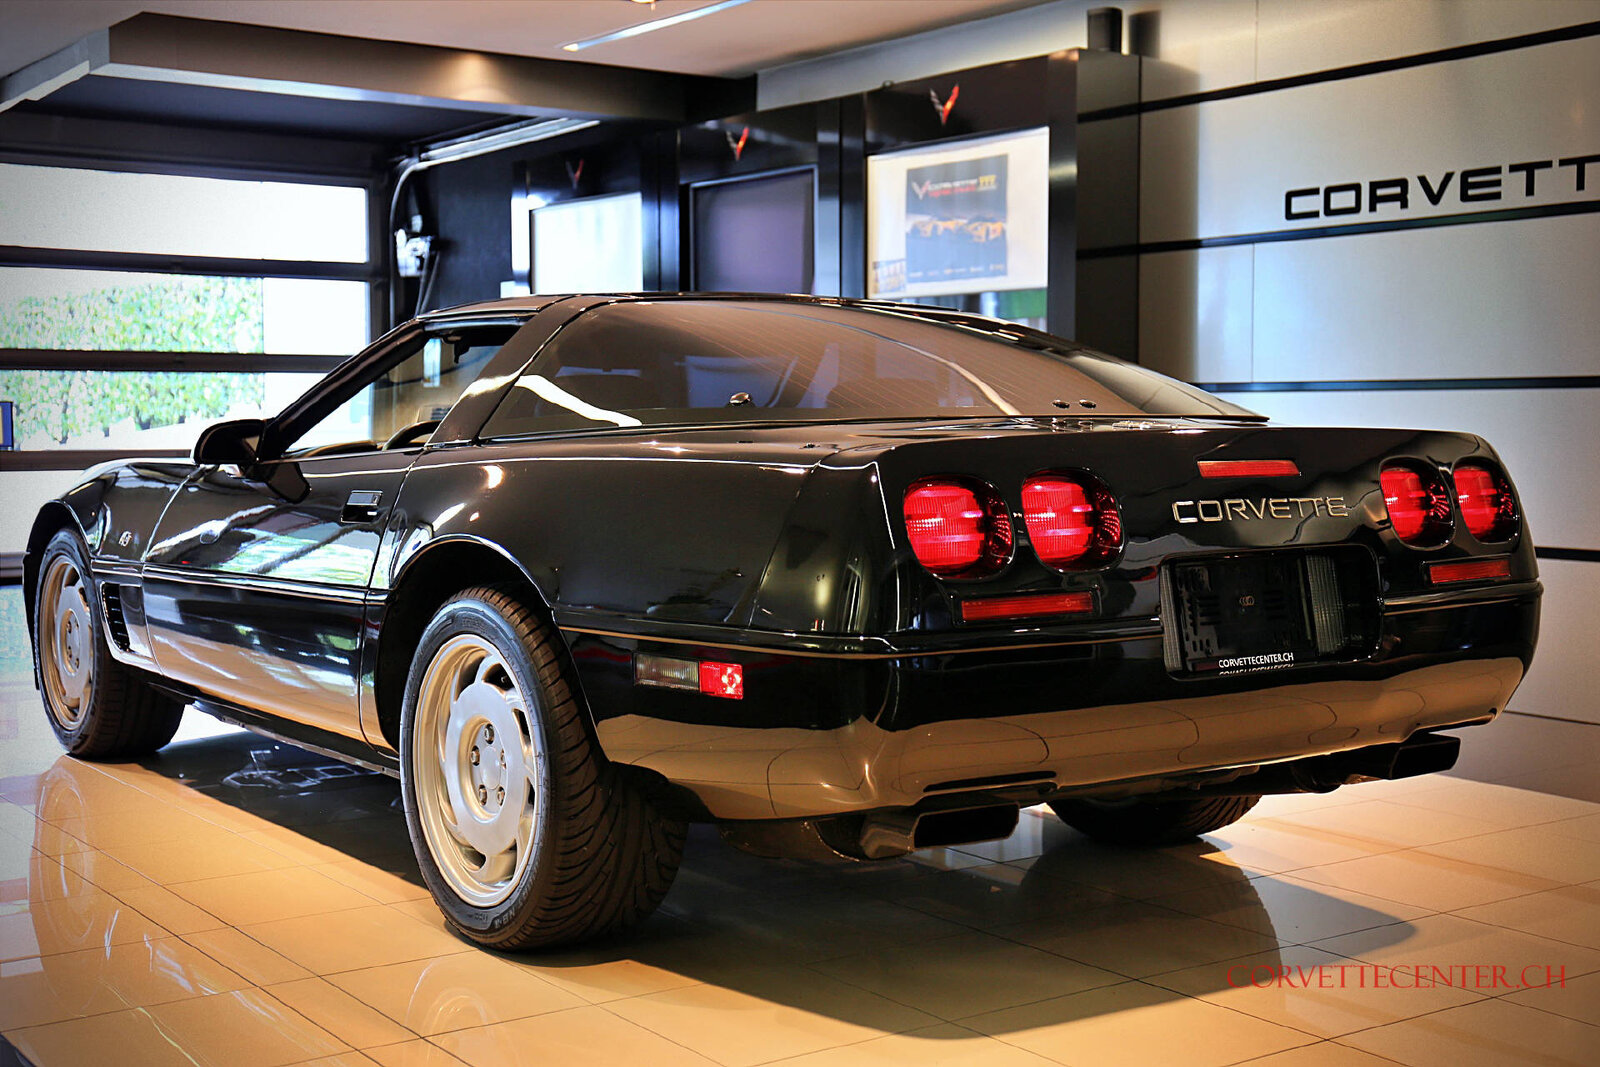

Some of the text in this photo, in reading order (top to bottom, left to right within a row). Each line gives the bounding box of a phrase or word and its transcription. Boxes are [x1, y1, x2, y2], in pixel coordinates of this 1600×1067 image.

[1284, 154, 1600, 221] CORVETT
[1171, 496, 1349, 524] CORVETTE
[1218, 651, 1295, 668] CORVETTECENTER.CH
